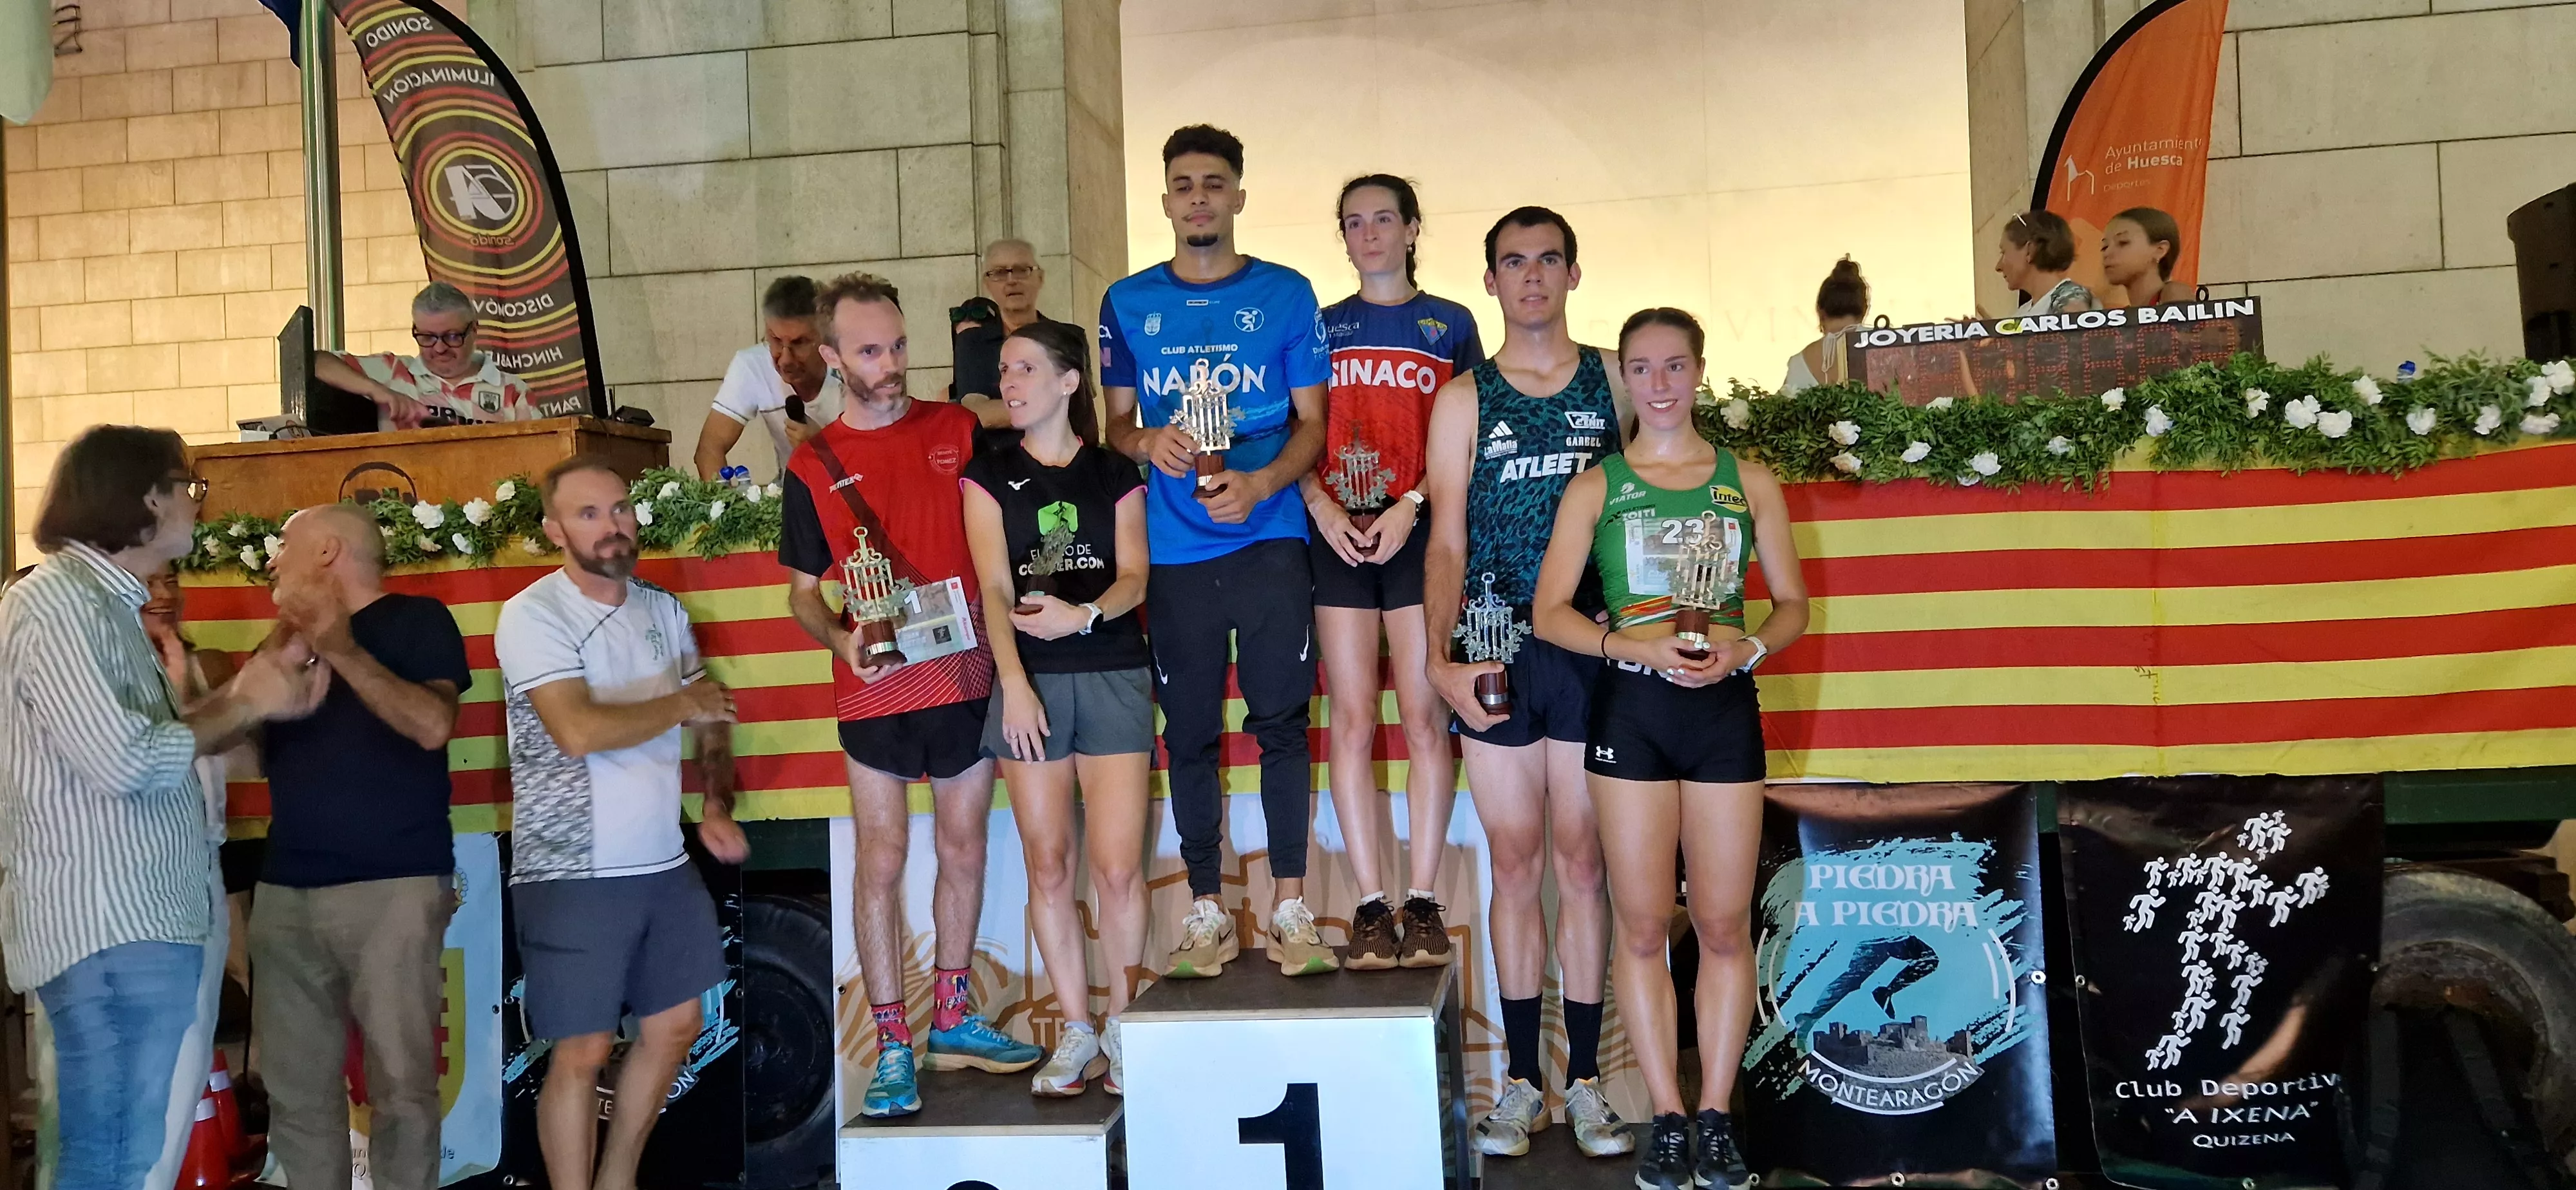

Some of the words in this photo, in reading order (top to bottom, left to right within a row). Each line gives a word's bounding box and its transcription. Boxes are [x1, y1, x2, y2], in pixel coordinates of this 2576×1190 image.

[2105, 162, 2122, 175] de
[2127, 155, 2183, 170] Huesca
[1327, 322, 1359, 334] uesca
[1853, 322, 1989, 348] JOYERIA
[1995, 309, 2127, 335] CARLOS
[2137, 299, 2254, 325] BAILIN
[1161, 346, 1186, 355] CLUB
[1187, 344, 1238, 354] ATLETISMO
[1609, 491, 1647, 506] VIATOR
[1077, 543, 1092, 556] DE
[1018, 556, 1104, 576] COER.COM
[1808, 864, 1956, 897] PIEDRA
[1791, 901, 1821, 933] A
[1832, 900, 1979, 934] PIEDRA
[1797, 1059, 1979, 1108] MONTEARAGÓN
[2115, 1080, 2183, 1099] Club
[2201, 1072, 2340, 1100] Deportiv
[1238, 1082, 1325, 1190] 1
[2192, 1132, 2296, 1149] QUIZENA
